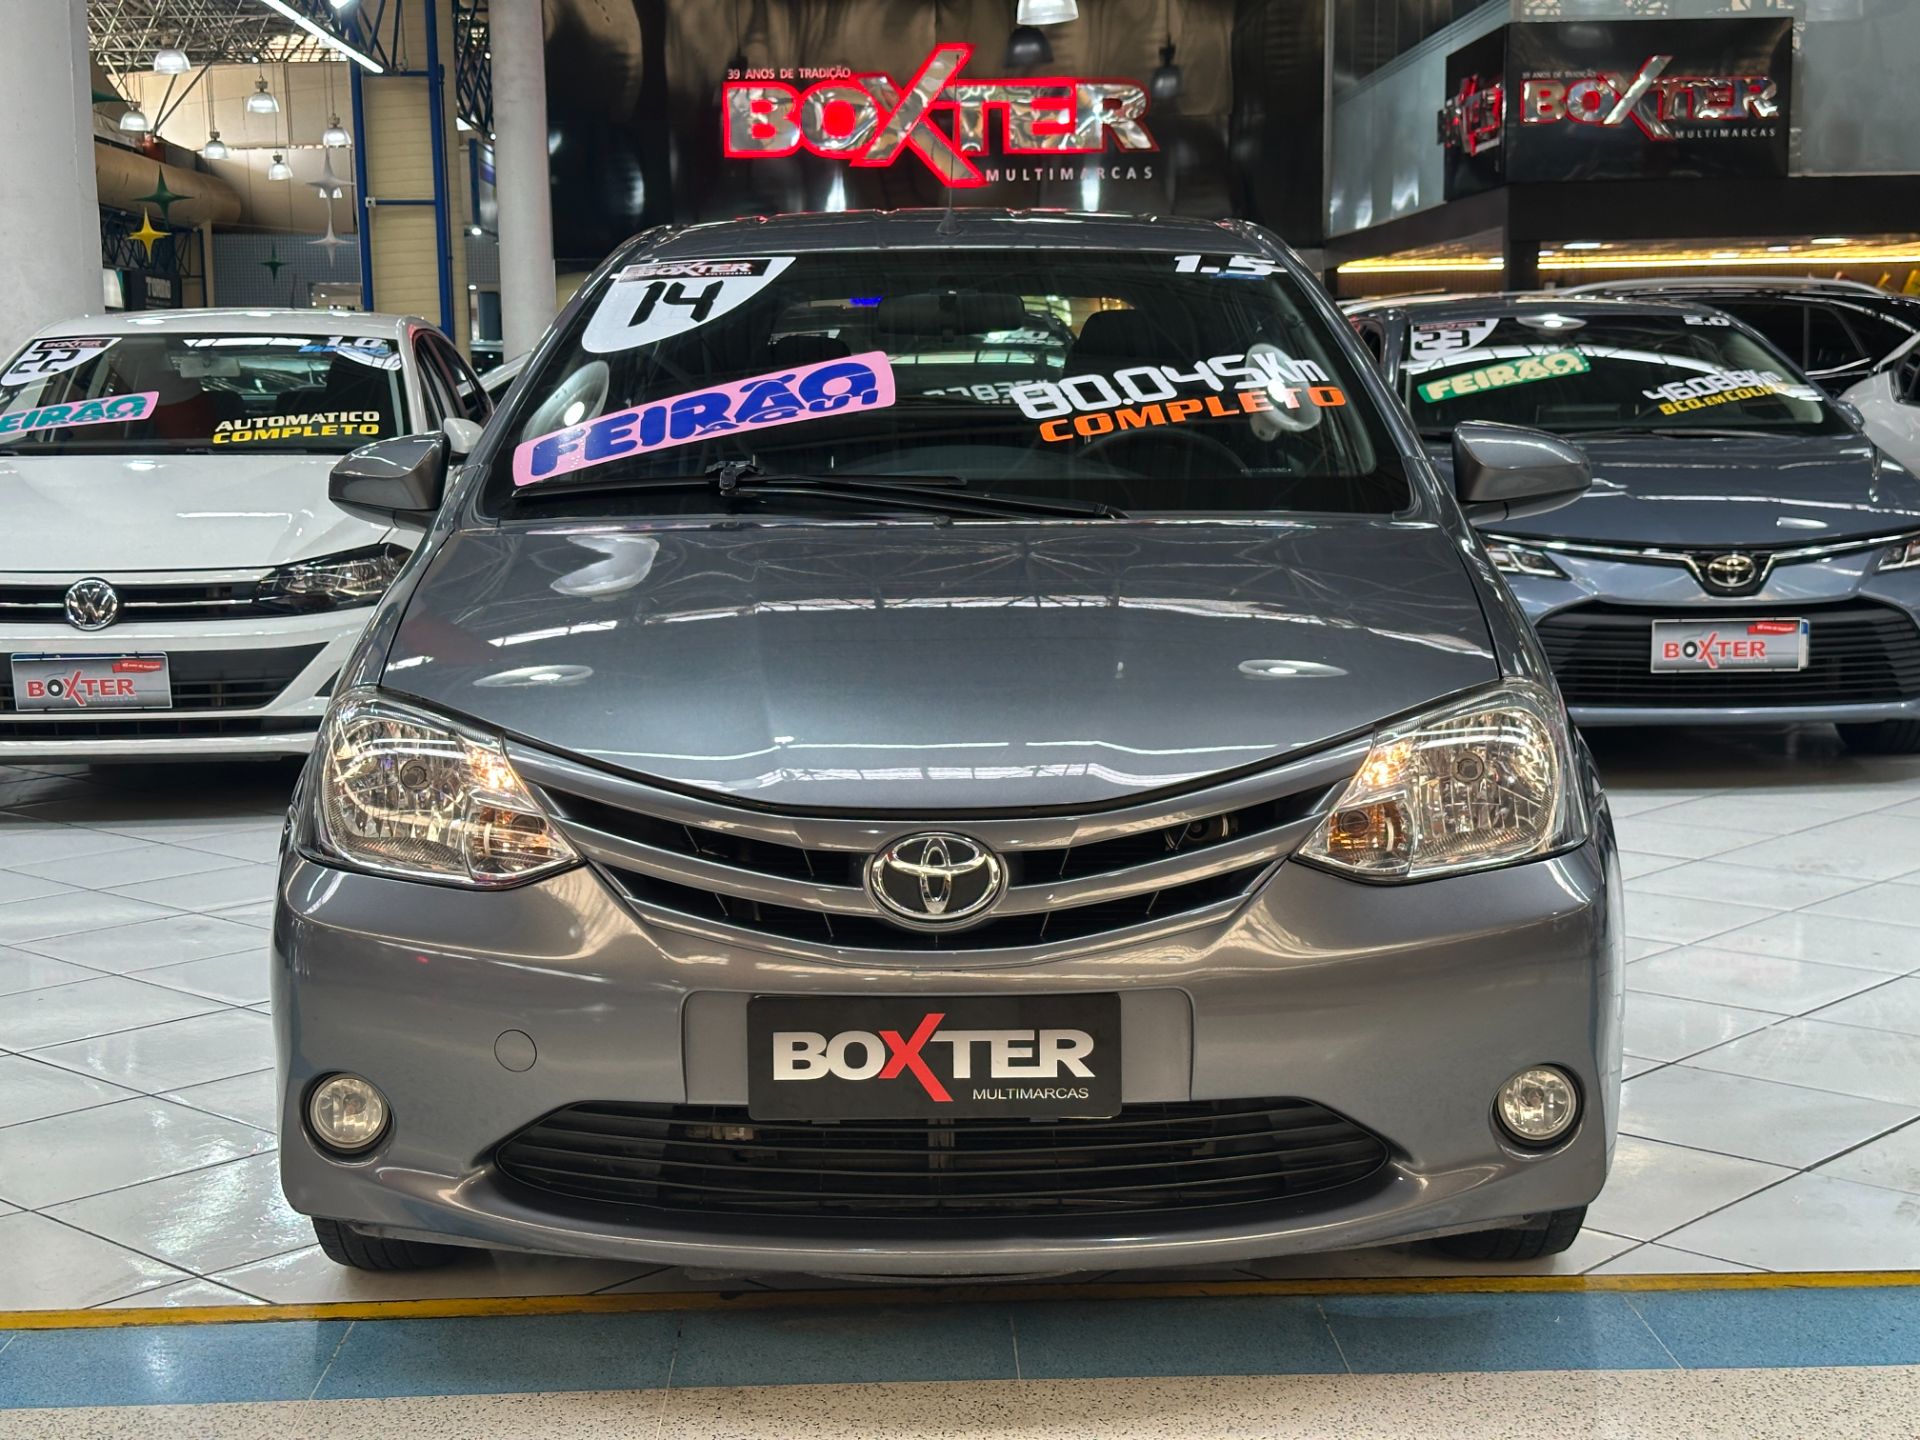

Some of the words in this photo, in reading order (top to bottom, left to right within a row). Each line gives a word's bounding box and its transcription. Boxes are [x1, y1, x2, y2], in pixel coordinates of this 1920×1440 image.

[727, 69, 740, 79] 39
[745, 69, 775, 79] ANOS
[780, 68, 794, 78] DE
[799, 65, 852, 80] TRADIÇÃO
[1521, 55, 1779, 140] BOXTER
[723, 43, 1160, 186] BOXTER
[1675, 128, 1776, 139] MULTIMARCAS
[985, 167, 1153, 182] MULTIMARCAS
[1174, 254, 1277, 276] 1.5
[627, 280, 724, 328] 14
[1683, 315, 1730, 326] 2.0
[1415, 330, 1470, 350] 23
[10, 349, 81, 374] 22
[1425, 352, 1581, 399] FEIRÃO
[531, 362, 877, 476] FEIRÃO
[1040, 386, 1346, 442] COMPLETO
[212, 424, 380, 444] COMPLETO
[1663, 631, 1767, 669] BOXTER
[26, 669, 137, 707] BOXTER
[773, 1013, 1096, 1102] BOXTER
[972, 1087, 1089, 1100] MULTIMARCAS
